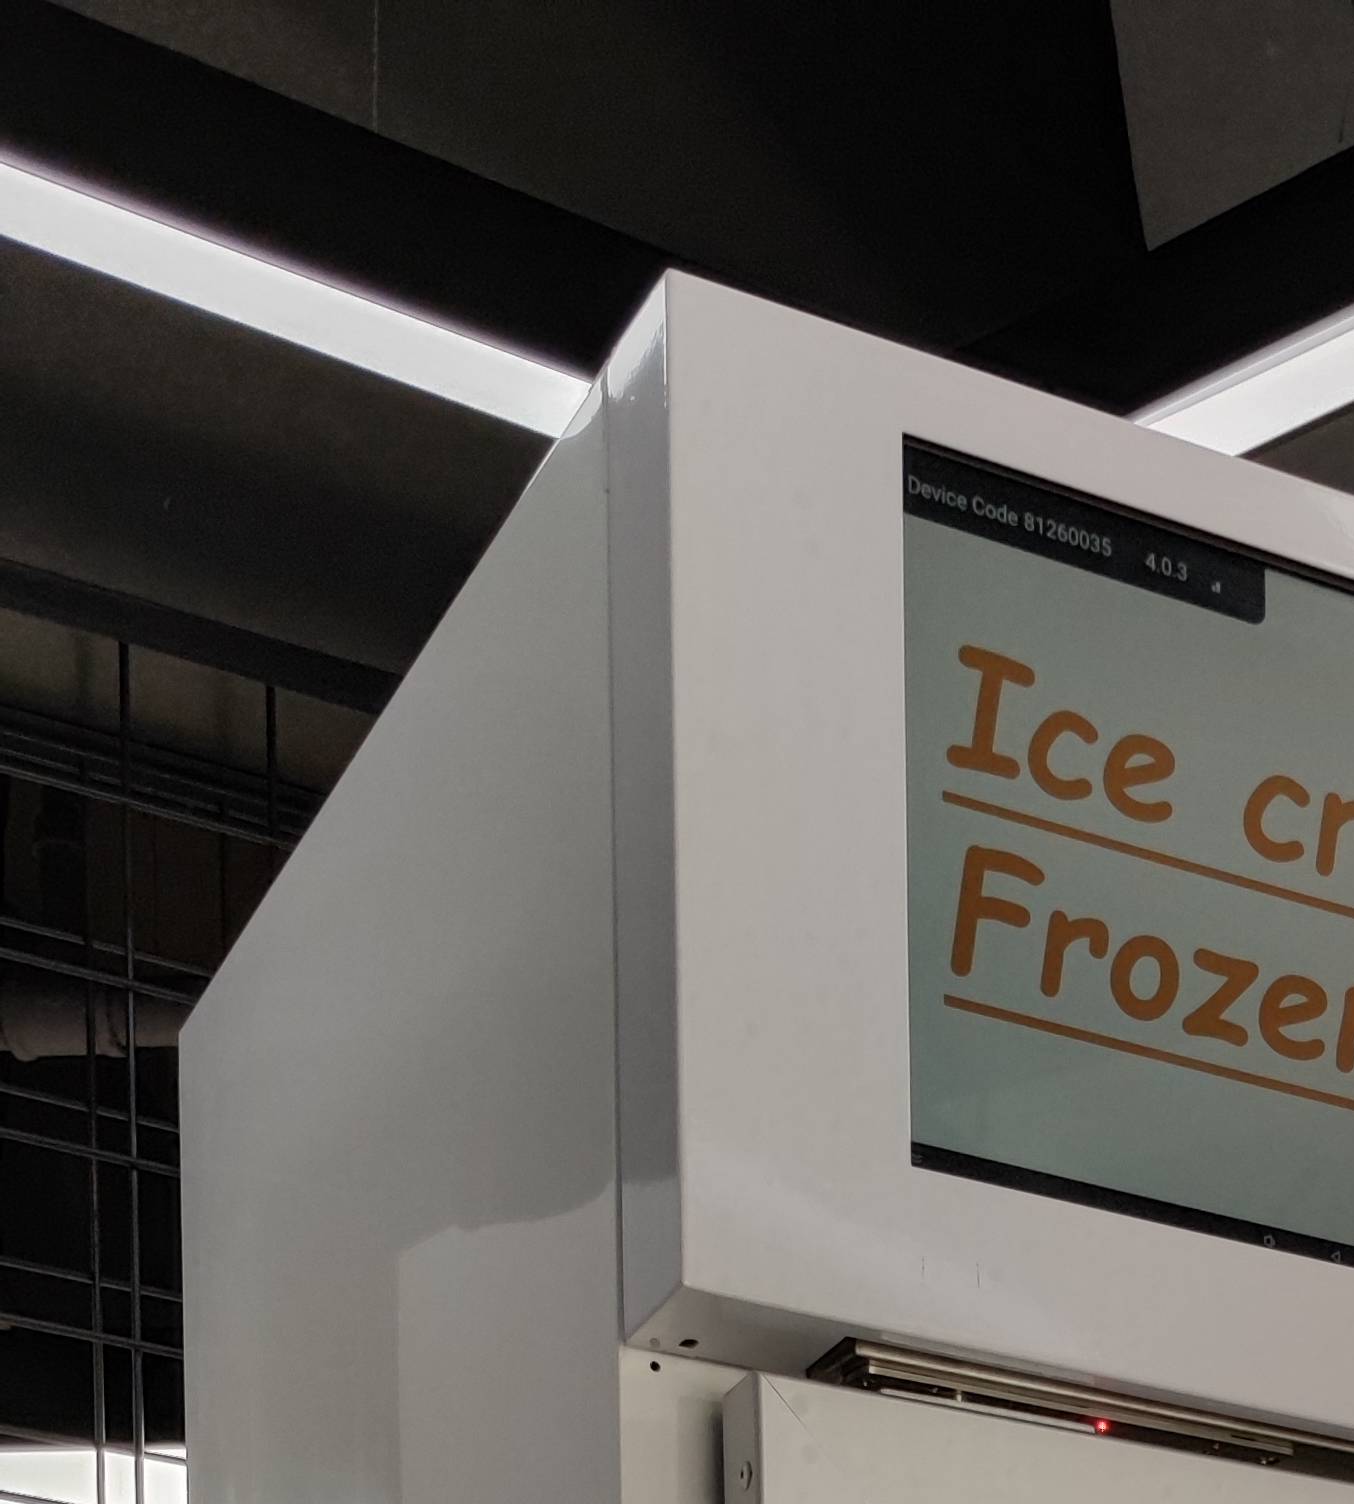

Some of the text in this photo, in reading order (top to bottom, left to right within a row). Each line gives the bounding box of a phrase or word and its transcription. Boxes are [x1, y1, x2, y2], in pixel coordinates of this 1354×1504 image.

[907, 475, 1188, 582] Device Code 81260035 4.0.3
[946, 643, 1176, 823] Ice
